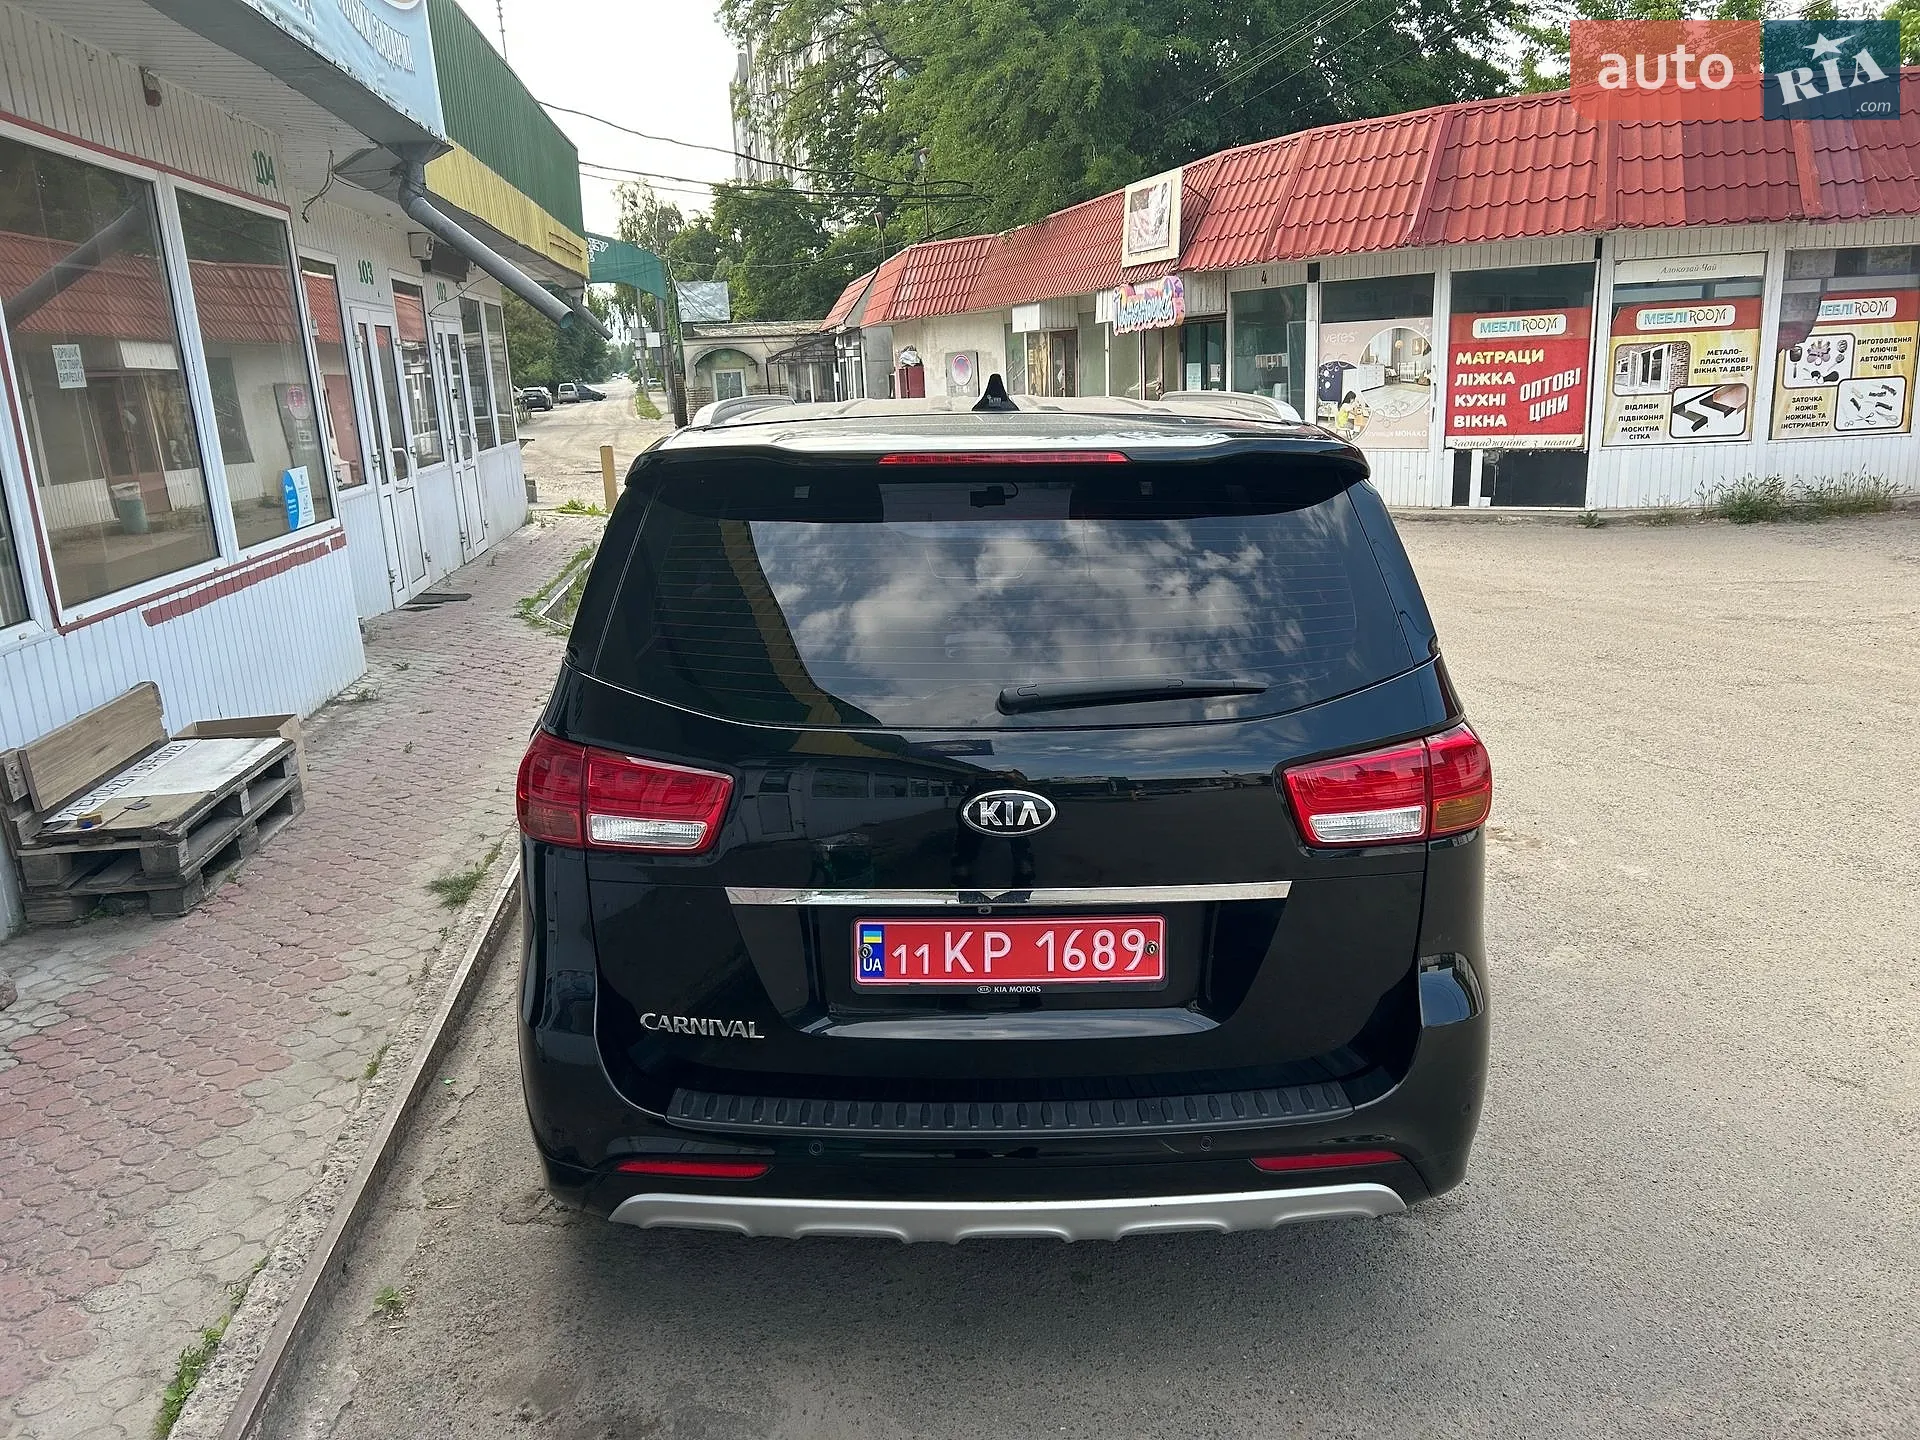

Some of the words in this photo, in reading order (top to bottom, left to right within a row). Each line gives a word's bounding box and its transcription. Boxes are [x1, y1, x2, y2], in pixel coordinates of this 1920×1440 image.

[357, 259, 374, 285] 103
[1261, 270, 1267, 284] 4
[1857, 336, 1912, 346] ВИГОТОВЛЕННЯ
[1706, 348, 1743, 356] МЕТАЛО-
[1869, 346, 1898, 354] КЛЮЧІВ
[1455, 348, 1545, 366] МАТРАЦИ
[1699, 356, 1749, 365] ПЛАСТИКОВІ
[1859, 354, 1906, 363] АВТОКЛЮЧІВ
[1729, 365, 1753, 373] ДВЕРІ
[1872, 363, 1892, 371] ЧІПІВ
[1454, 371, 1516, 387] ЛІЖКА
[1519, 367, 1581, 402] ОПТОВІ
[1454, 393, 1506, 408] КУХНІ
[1792, 396, 1823, 404] ЗАТОЧКА
[1529, 393, 1569, 422] ЦІНИ
[1624, 403, 1659, 411] ВІДЛИВИ
[1453, 413, 1508, 428] ВІКНА
[1618, 414, 1664, 422] ПІДВІКОННЯ
[1785, 413, 1816, 421] НОЖИЦЬ
[1621, 425, 1660, 433] МОСКІТНА
[1781, 421, 1829, 430] ІНСТРУМЕНТУ
[1543, 438, 1577, 446] нами!
[979, 801, 1041, 826] KIA
[1035, 928, 1146, 972] 1689
[863, 958, 883, 972] UA
[1009, 985, 1041, 993] MOTORS
[640, 1013, 765, 1039] CARNIVAL
